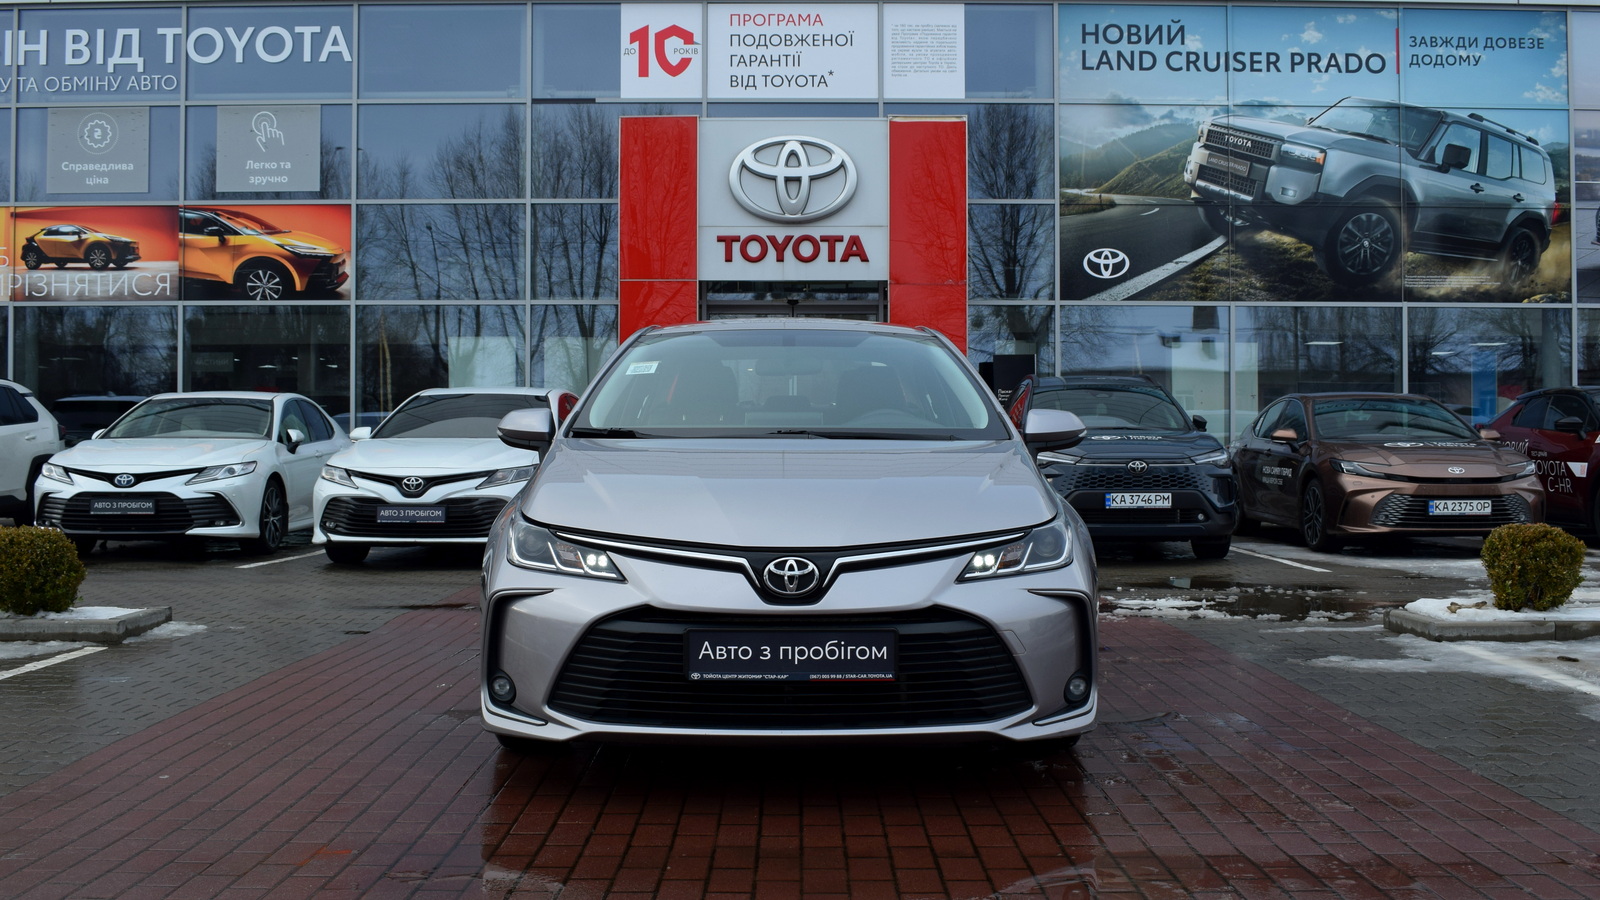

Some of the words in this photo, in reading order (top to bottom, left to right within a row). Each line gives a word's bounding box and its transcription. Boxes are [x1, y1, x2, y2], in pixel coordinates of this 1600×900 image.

[729, 13, 824, 27] ПРОГРАМА
[1081, 19, 1186, 45] НОВИЙ
[729, 30, 855, 50] ПОДОВЖЕНОЇ
[1408, 36, 1479, 50] ЗАВЖДИ
[1483, 37, 1545, 51] ДОВЕЗЕ
[64, 28, 145, 73] ВІД
[156, 26, 353, 64] TOYOTA
[623, 47, 637, 56] ДО
[673, 47, 699, 55] РОКІВ
[729, 51, 803, 67] ГАРАНТІЇ
[1081, 49, 1157, 71] LAND
[1165, 50, 1282, 73] CRUISER
[1289, 52, 1387, 74] PRADO
[1408, 54, 1482, 68] ДОДОМУ
[17, 76, 39, 92] ТА
[44, 76, 123, 92] ОБМІНУ
[127, 74, 178, 91] АВТО
[729, 74, 757, 91] ВІД
[1224, 135, 1252, 148] TOYOTA
[61, 161, 134, 173] Справедлива
[246, 160, 278, 169] Легко
[279, 161, 292, 169] та
[85, 175, 109, 186] ціна
[248, 176, 289, 185] зручно
[716, 234, 870, 264] TOYOTA
[0, 273, 171, 297] РІЗНЯТИСЯ
[1502, 439, 1530, 456] ВИЙ
[1547, 476, 1574, 494] C-HR
[1129, 494, 1153, 505] 3746
[1451, 502, 1475, 512] 2375
[379, 509, 398, 517] АВТО
[405, 509, 442, 517] ПРОБІГОМ
[698, 640, 753, 660] Авто
[759, 645, 772, 660] з
[779, 639, 888, 665] пробігом
